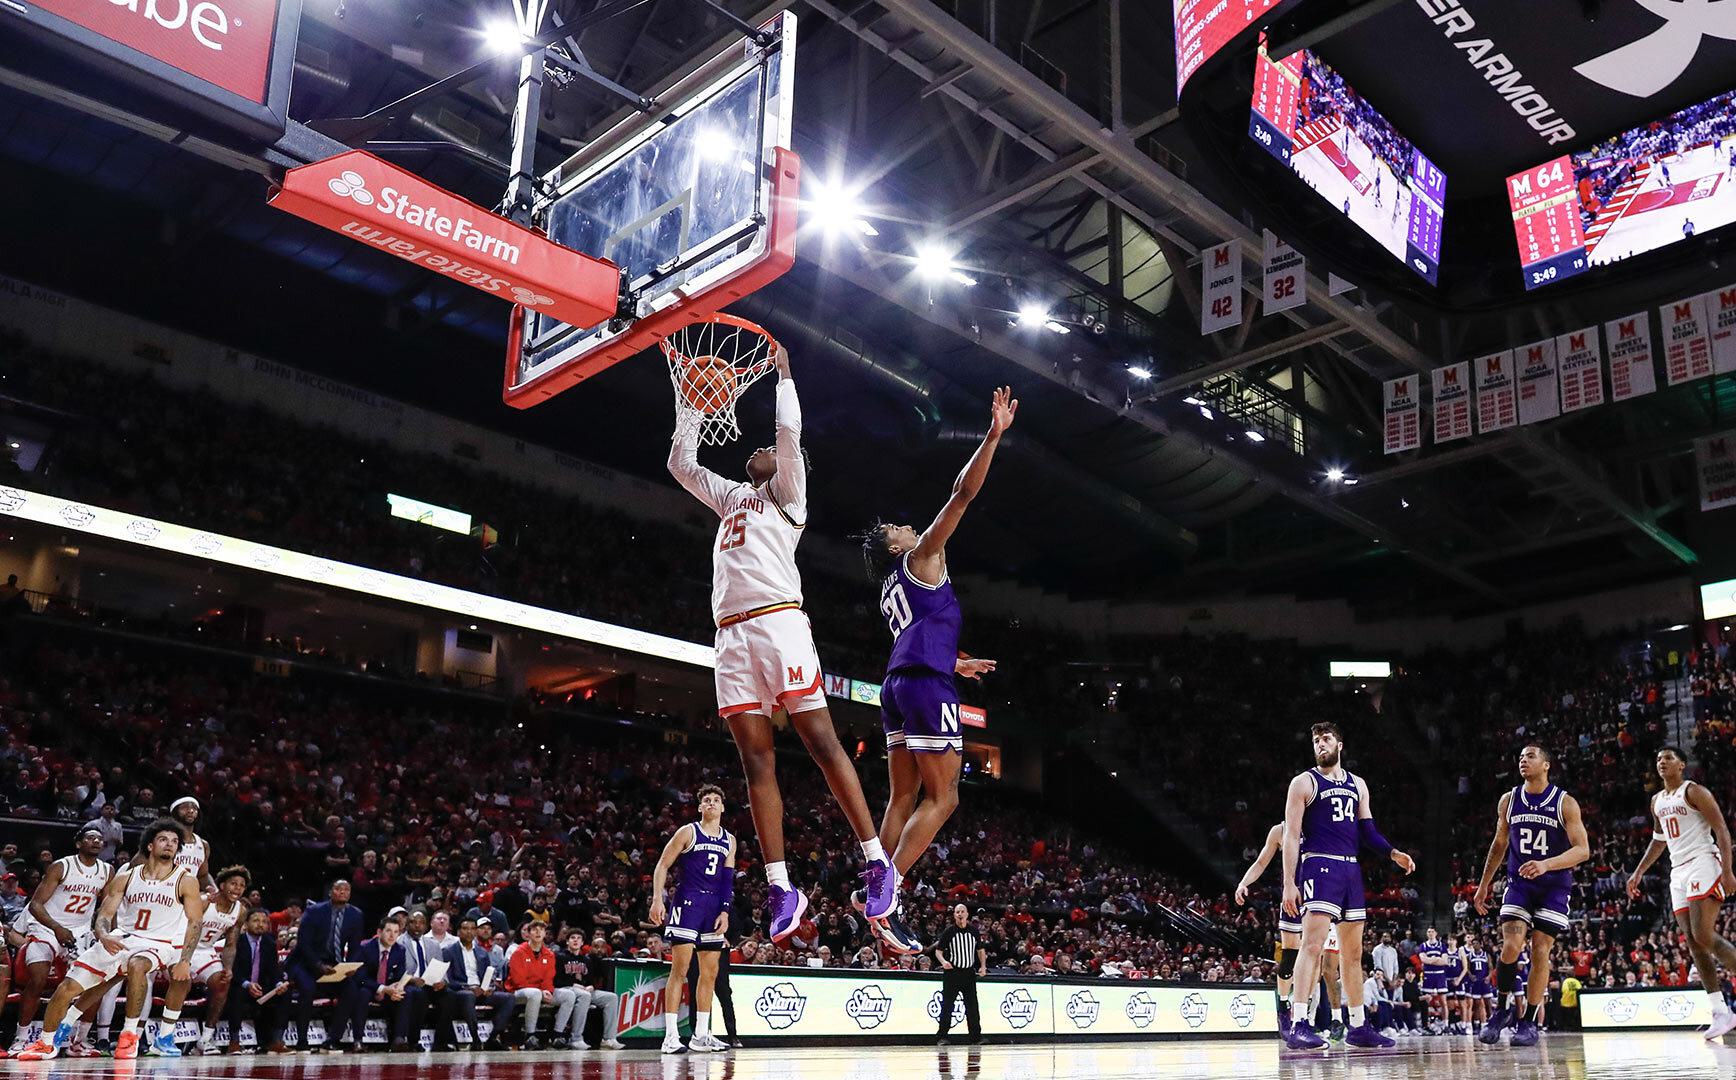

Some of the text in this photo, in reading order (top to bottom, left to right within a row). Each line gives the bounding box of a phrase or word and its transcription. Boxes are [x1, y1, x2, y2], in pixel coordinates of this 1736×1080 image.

[1453, 38, 1577, 146] ARMOUR
[1254, 124, 1289, 159] 3:49 19
[1417, 154, 1443, 193] N 57
[1511, 162, 1565, 198] M 64
[1526, 202, 1572, 225] 0 14 2
[1528, 211, 1573, 234] 1 11 2
[1529, 219, 1574, 243] 5 0 1
[1529, 228, 1577, 253] 10 14 2
[1214, 245, 1229, 268] M
[1529, 237, 1578, 261] 25 8 4
[1210, 275, 1234, 290] JONES
[1532, 258, 1584, 284] 3:49 19
[1273, 275, 1295, 300] 32
[1211, 295, 1232, 318] 42
[1673, 301, 1692, 322] M
[1618, 318, 1636, 339] M
[1569, 332, 1585, 353] M
[1486, 355, 1501, 375] M
[1527, 345, 1543, 365] M
[1562, 356, 1597, 371] SIXTEEN
[254, 358, 292, 381] JOHN
[1443, 367, 1457, 386] M
[1394, 379, 1407, 397] M
[584, 461, 617, 481] PRICE
[719, 511, 747, 553] 25
[880, 583, 913, 646] 20
[788, 666, 804, 682] M
[831, 675, 845, 694] M
[941, 702, 959, 733] N
[961, 710, 985, 723] TOYOTA
[1320, 787, 1359, 801] NORTHWESTERN
[1331, 797, 1355, 823] 34
[1510, 813, 1559, 828] NORTHWESTERN
[1666, 817, 1681, 840] 10
[1520, 827, 1550, 856] 24
[705, 853, 719, 876] 3
[126, 892, 175, 908] MARYLAND
[1303, 878, 1315, 902] N
[64, 894, 93, 915] 22
[669, 906, 683, 926] N
[134, 908, 152, 931] 0
[201, 929, 218, 943] 5
[755, 986, 807, 1023] Starry
[846, 988, 892, 1023] Starry
[1000, 992, 1038, 1024] Starry
